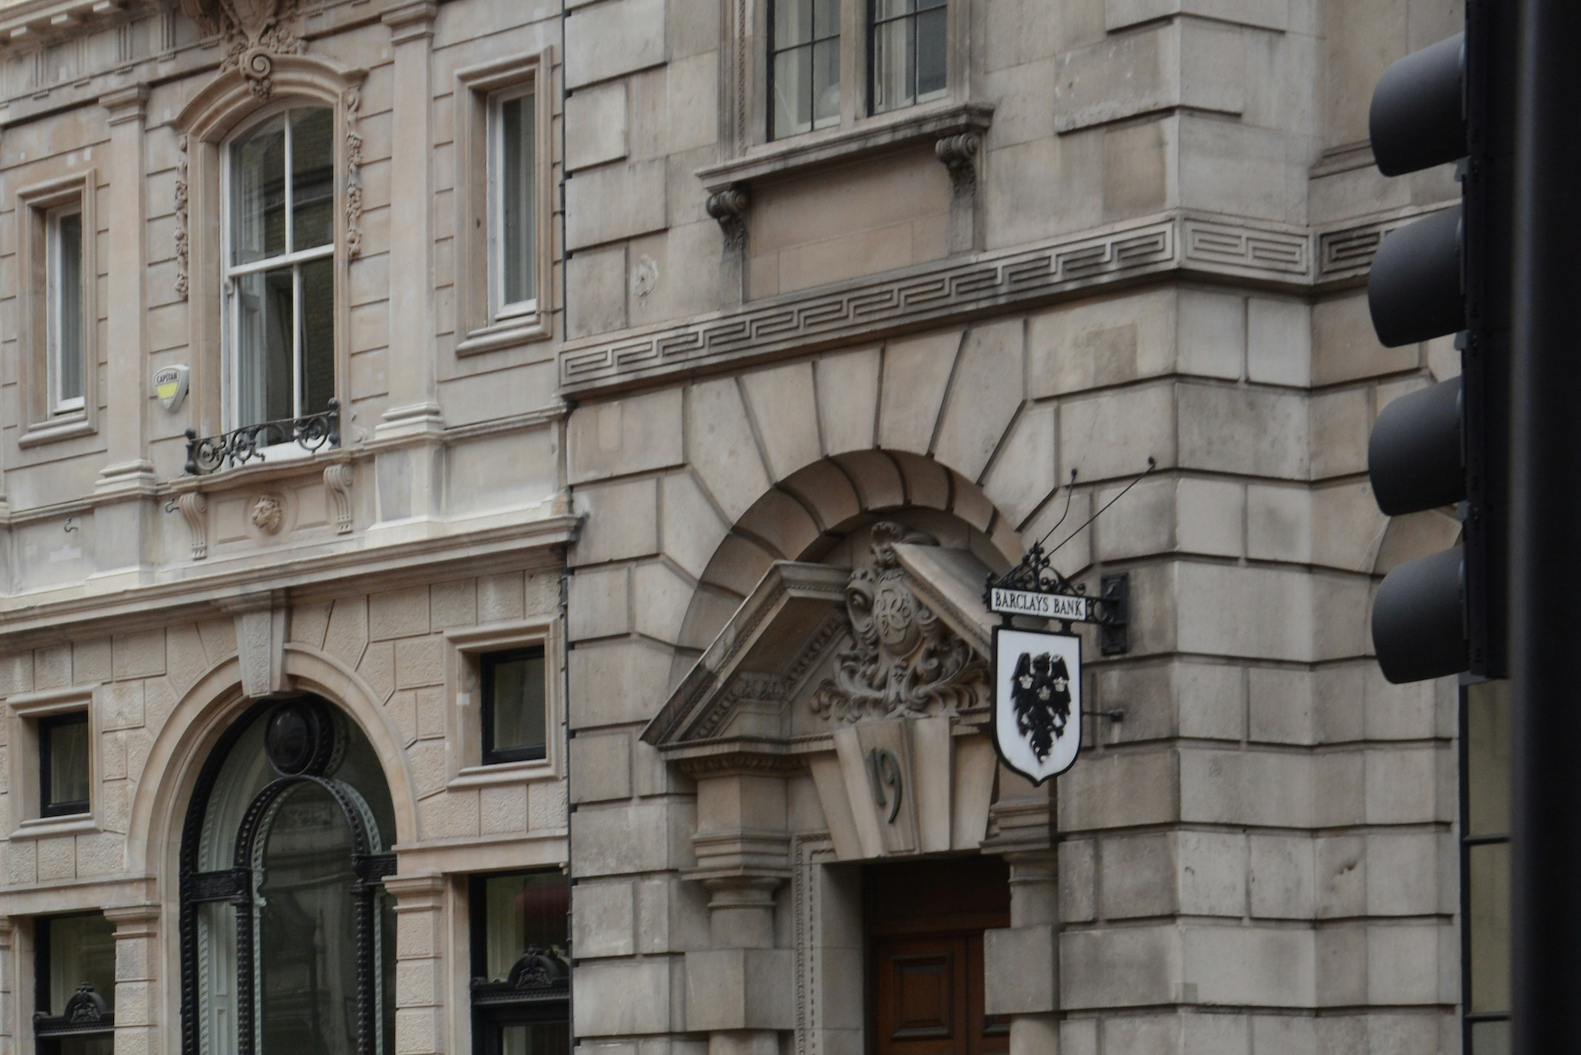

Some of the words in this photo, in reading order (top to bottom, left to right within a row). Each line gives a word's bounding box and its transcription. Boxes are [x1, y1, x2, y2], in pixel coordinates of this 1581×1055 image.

[157, 372, 177, 383] CAPSTAN
[995, 591, 1049, 612] BARCLAYS
[1053, 598, 1084, 617] BANK
